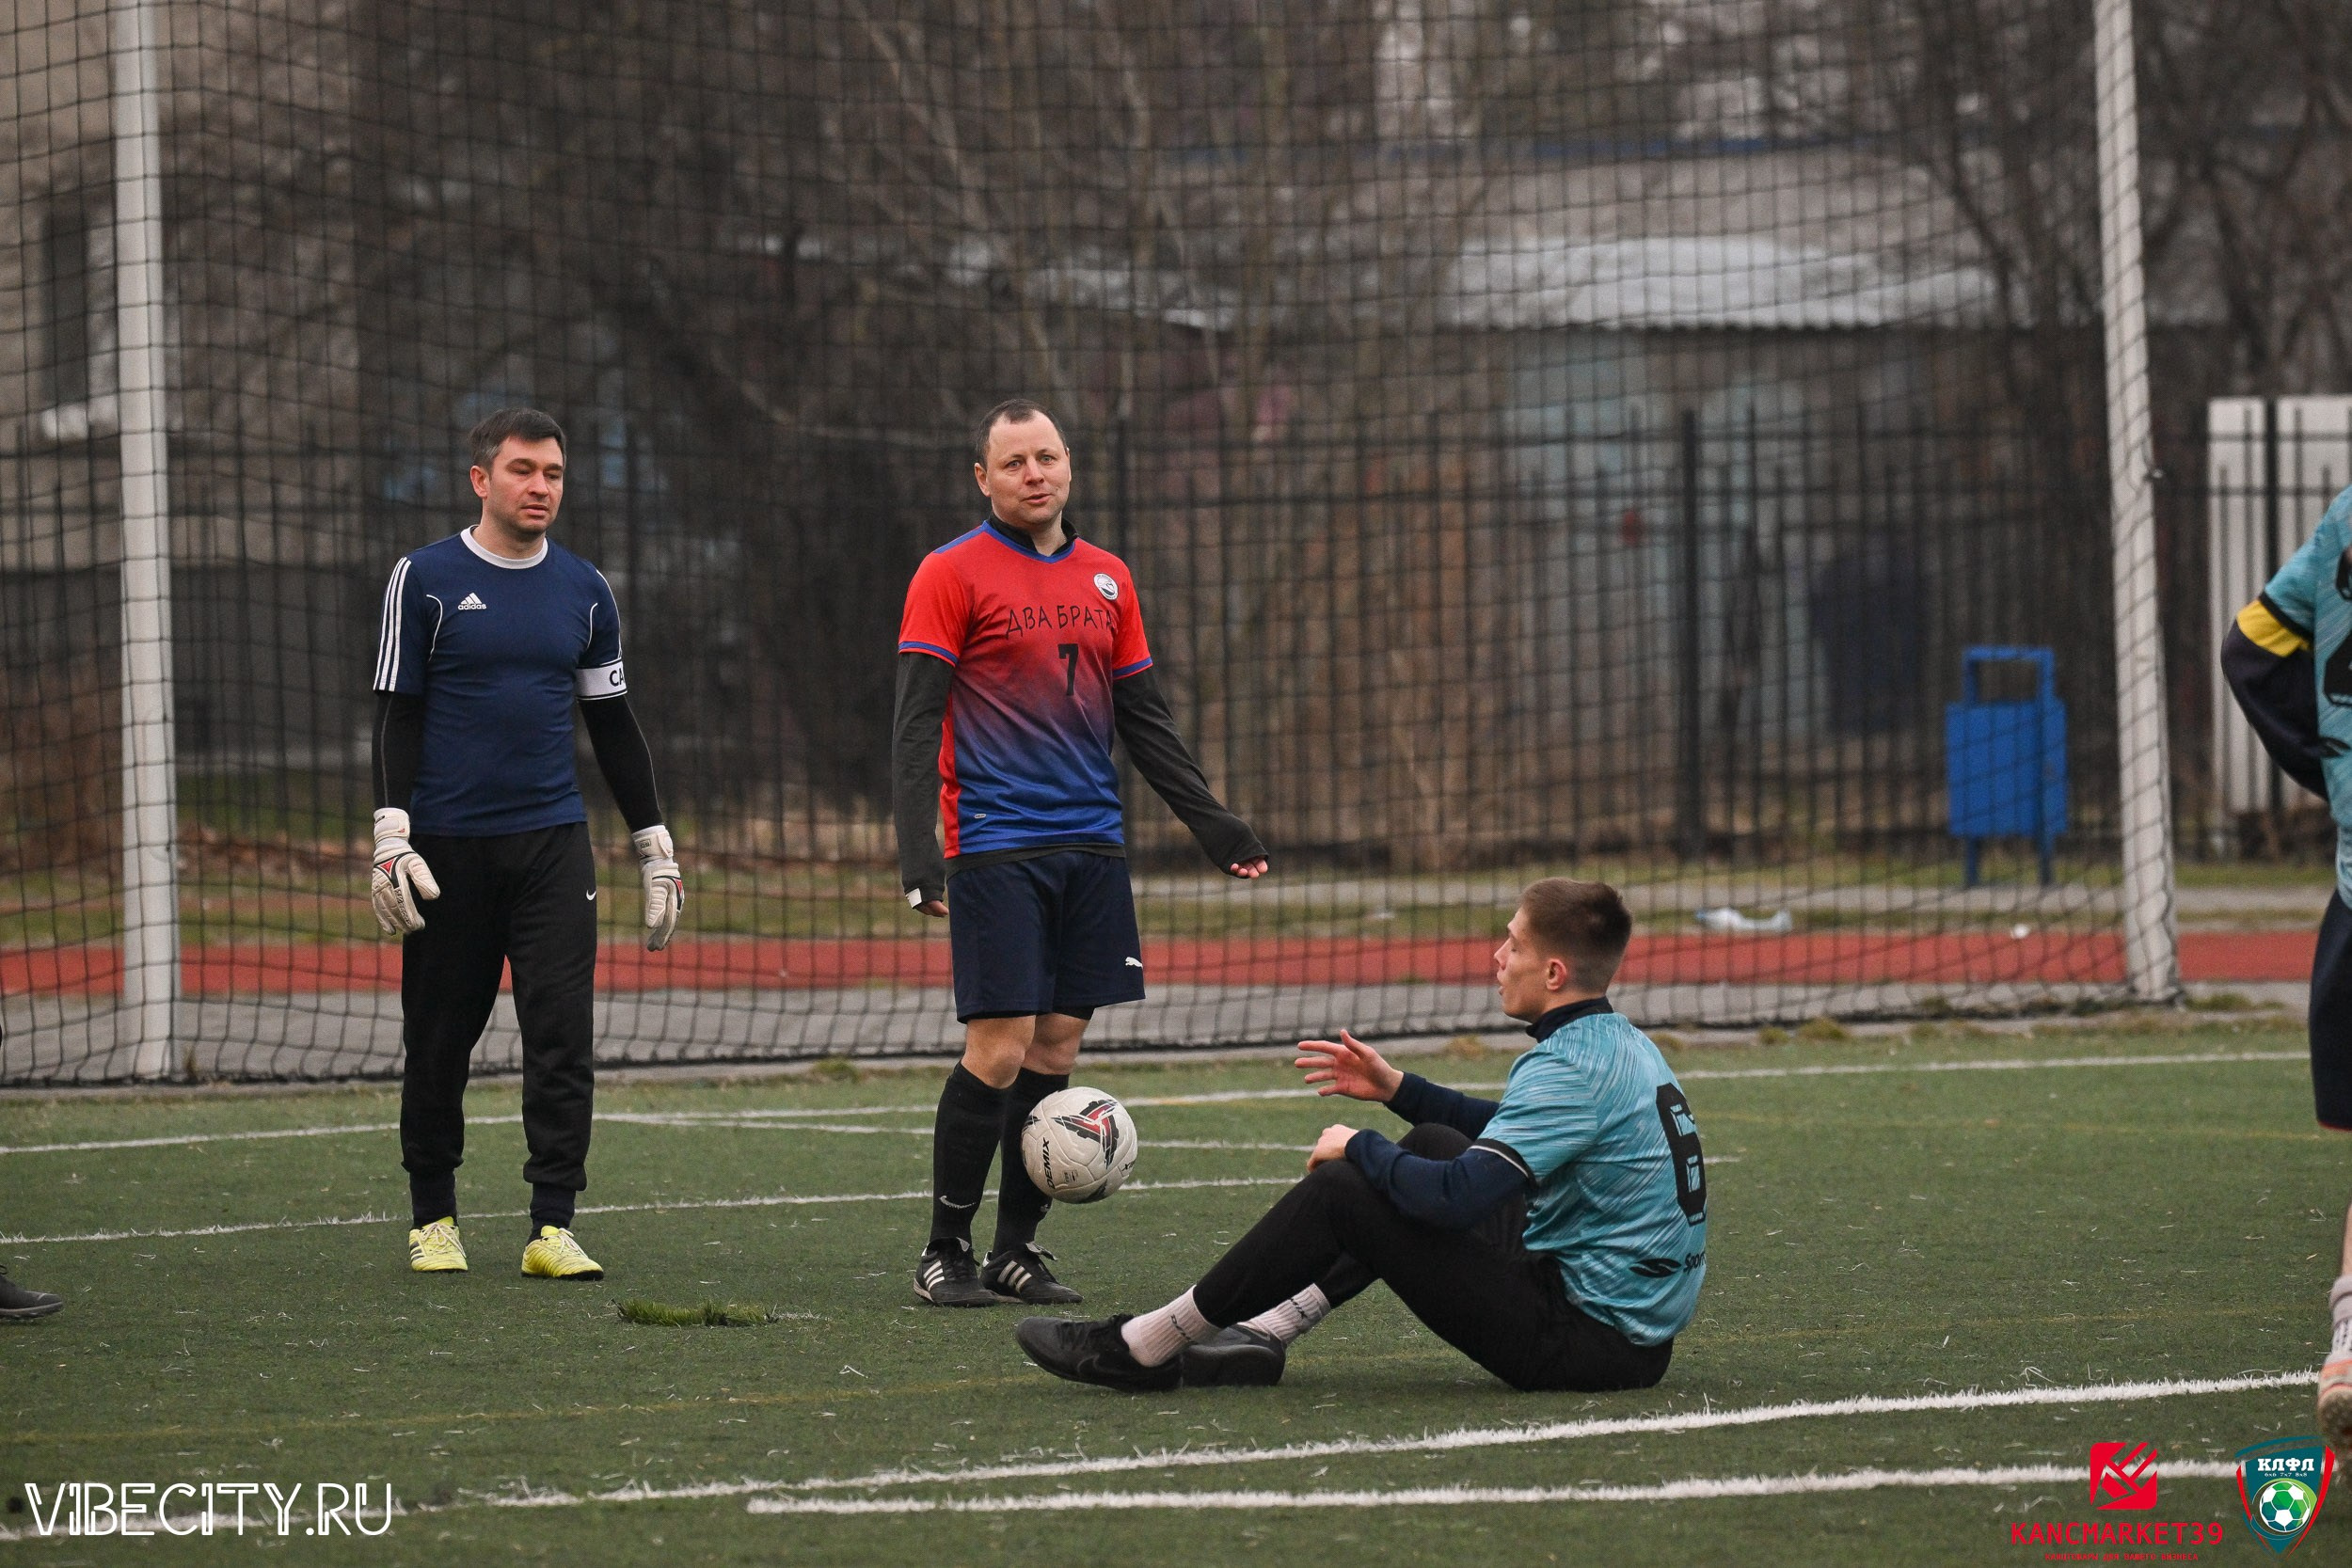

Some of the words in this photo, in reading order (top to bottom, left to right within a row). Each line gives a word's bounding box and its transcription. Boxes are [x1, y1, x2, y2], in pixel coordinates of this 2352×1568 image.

[457, 603, 487, 611] adidas
[1005, 605, 1053, 639] ДВА
[1057, 605, 1114, 631] БРАТА
[1057, 642, 1079, 696] 7
[1041, 1136, 1056, 1190] DEMIX
[1656, 1082, 1708, 1227] 6
